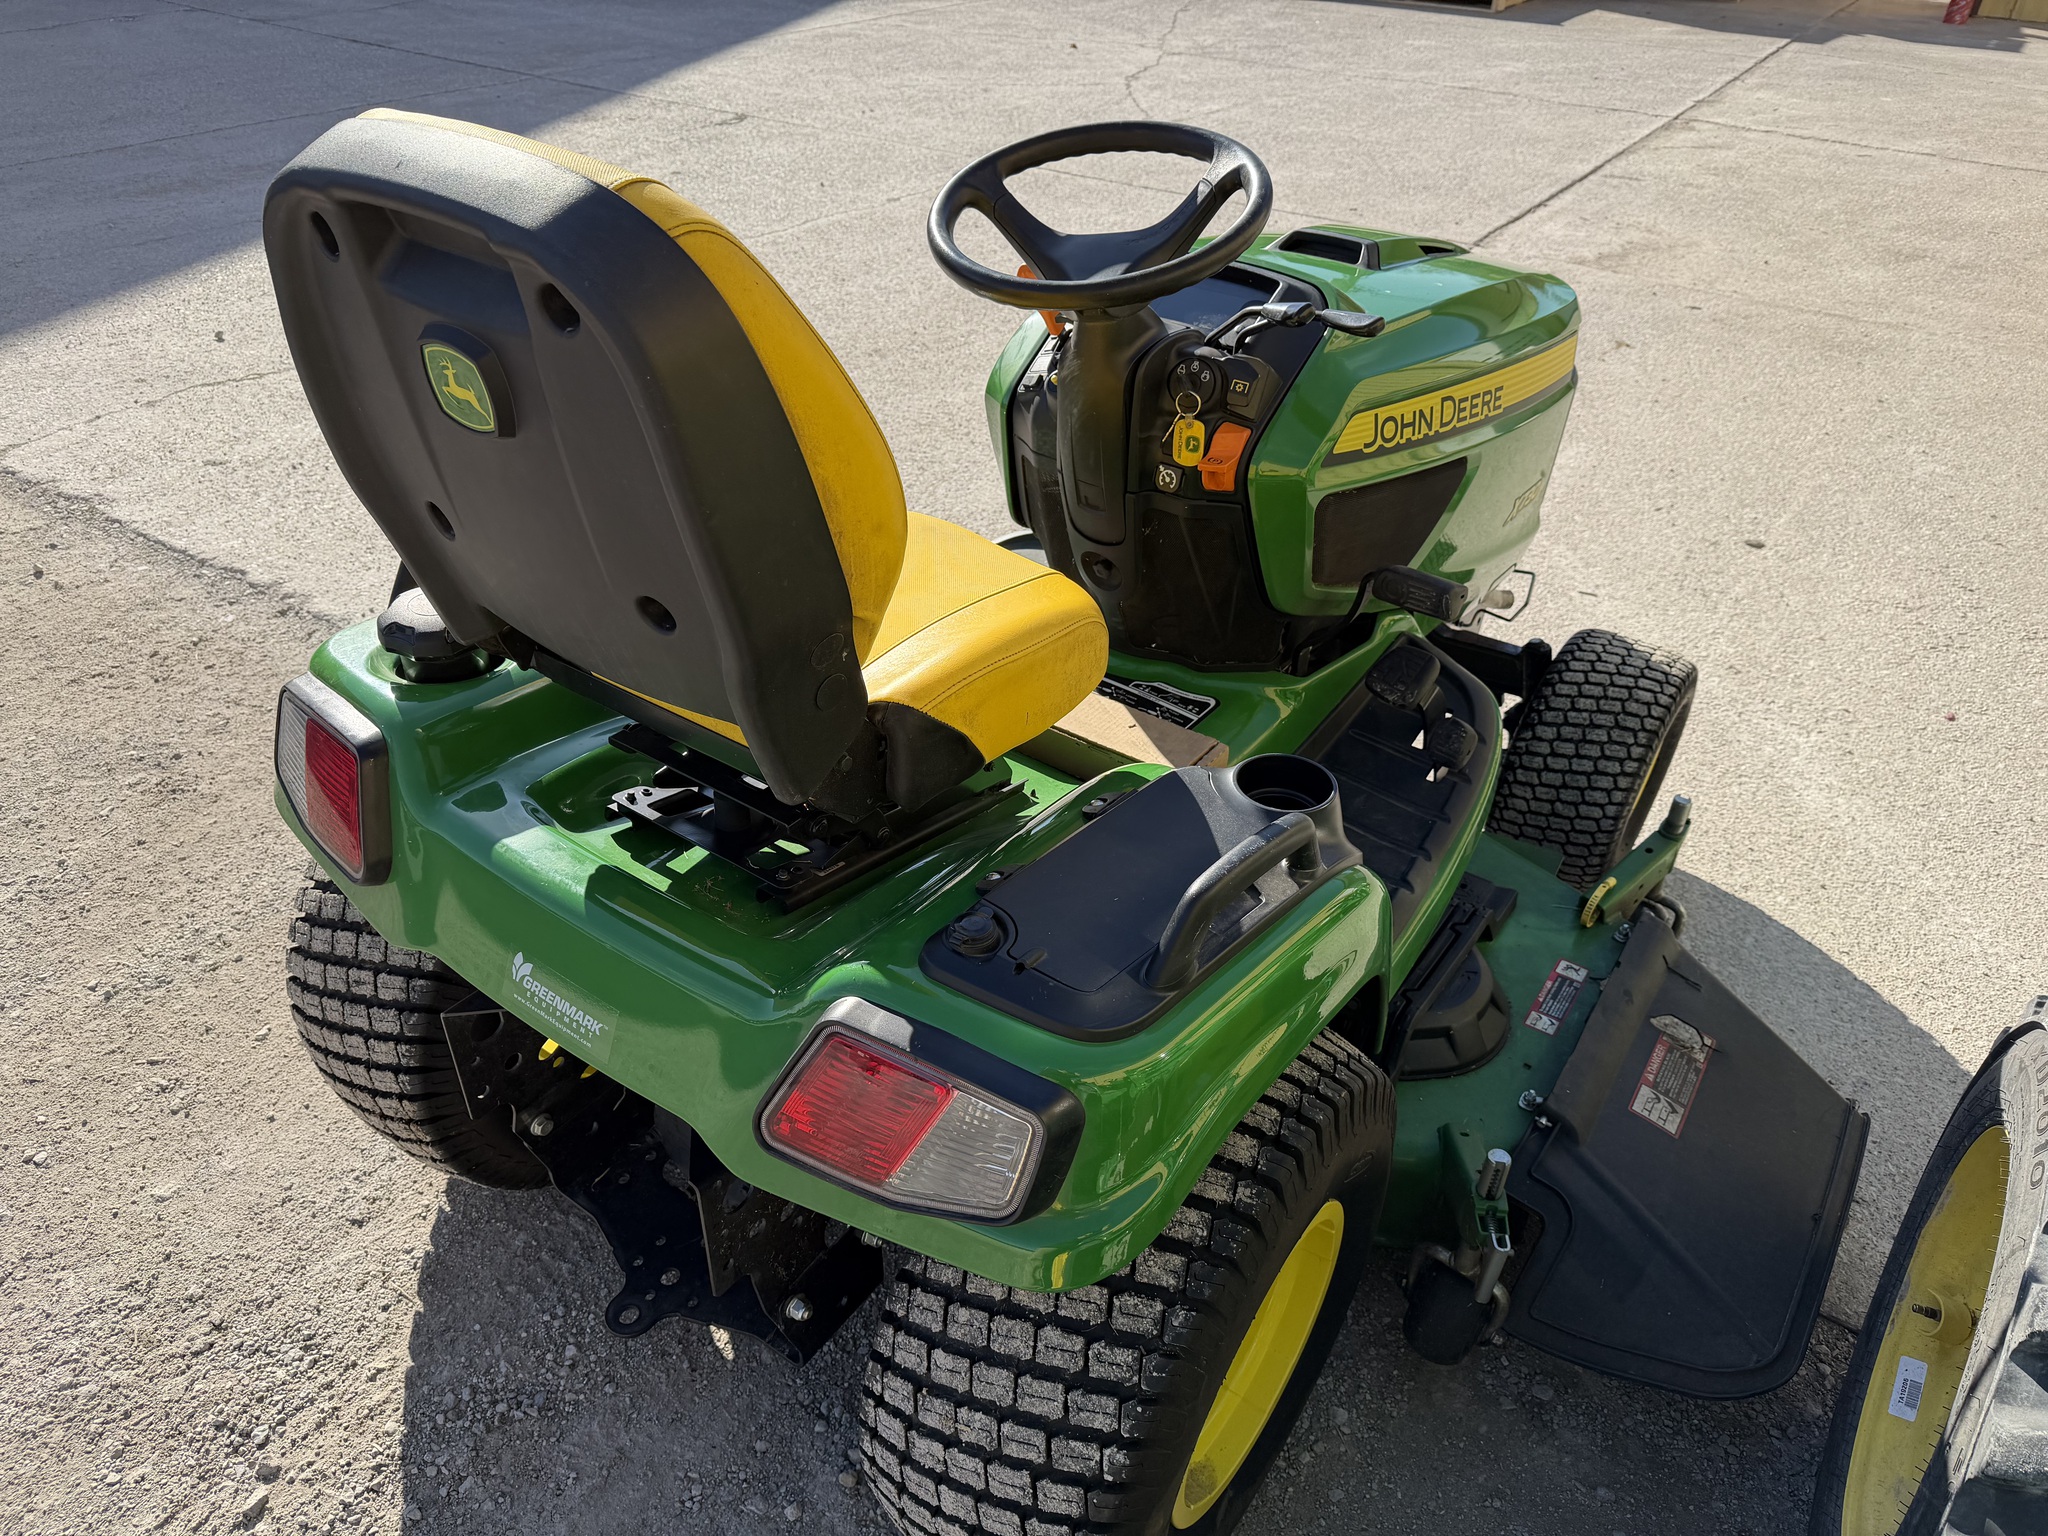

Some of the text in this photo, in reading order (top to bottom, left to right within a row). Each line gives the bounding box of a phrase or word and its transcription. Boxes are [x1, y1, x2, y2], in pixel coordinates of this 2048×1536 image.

[1363, 385, 1505, 450] JOHN DEERE
[513, 993, 592, 1048] www.GreenMarkEquipment.com
[522, 975, 601, 1036] GREENMARK
[526, 991, 594, 1038] EQUIPMENT
[1648, 1044, 1667, 1074] DANGER
